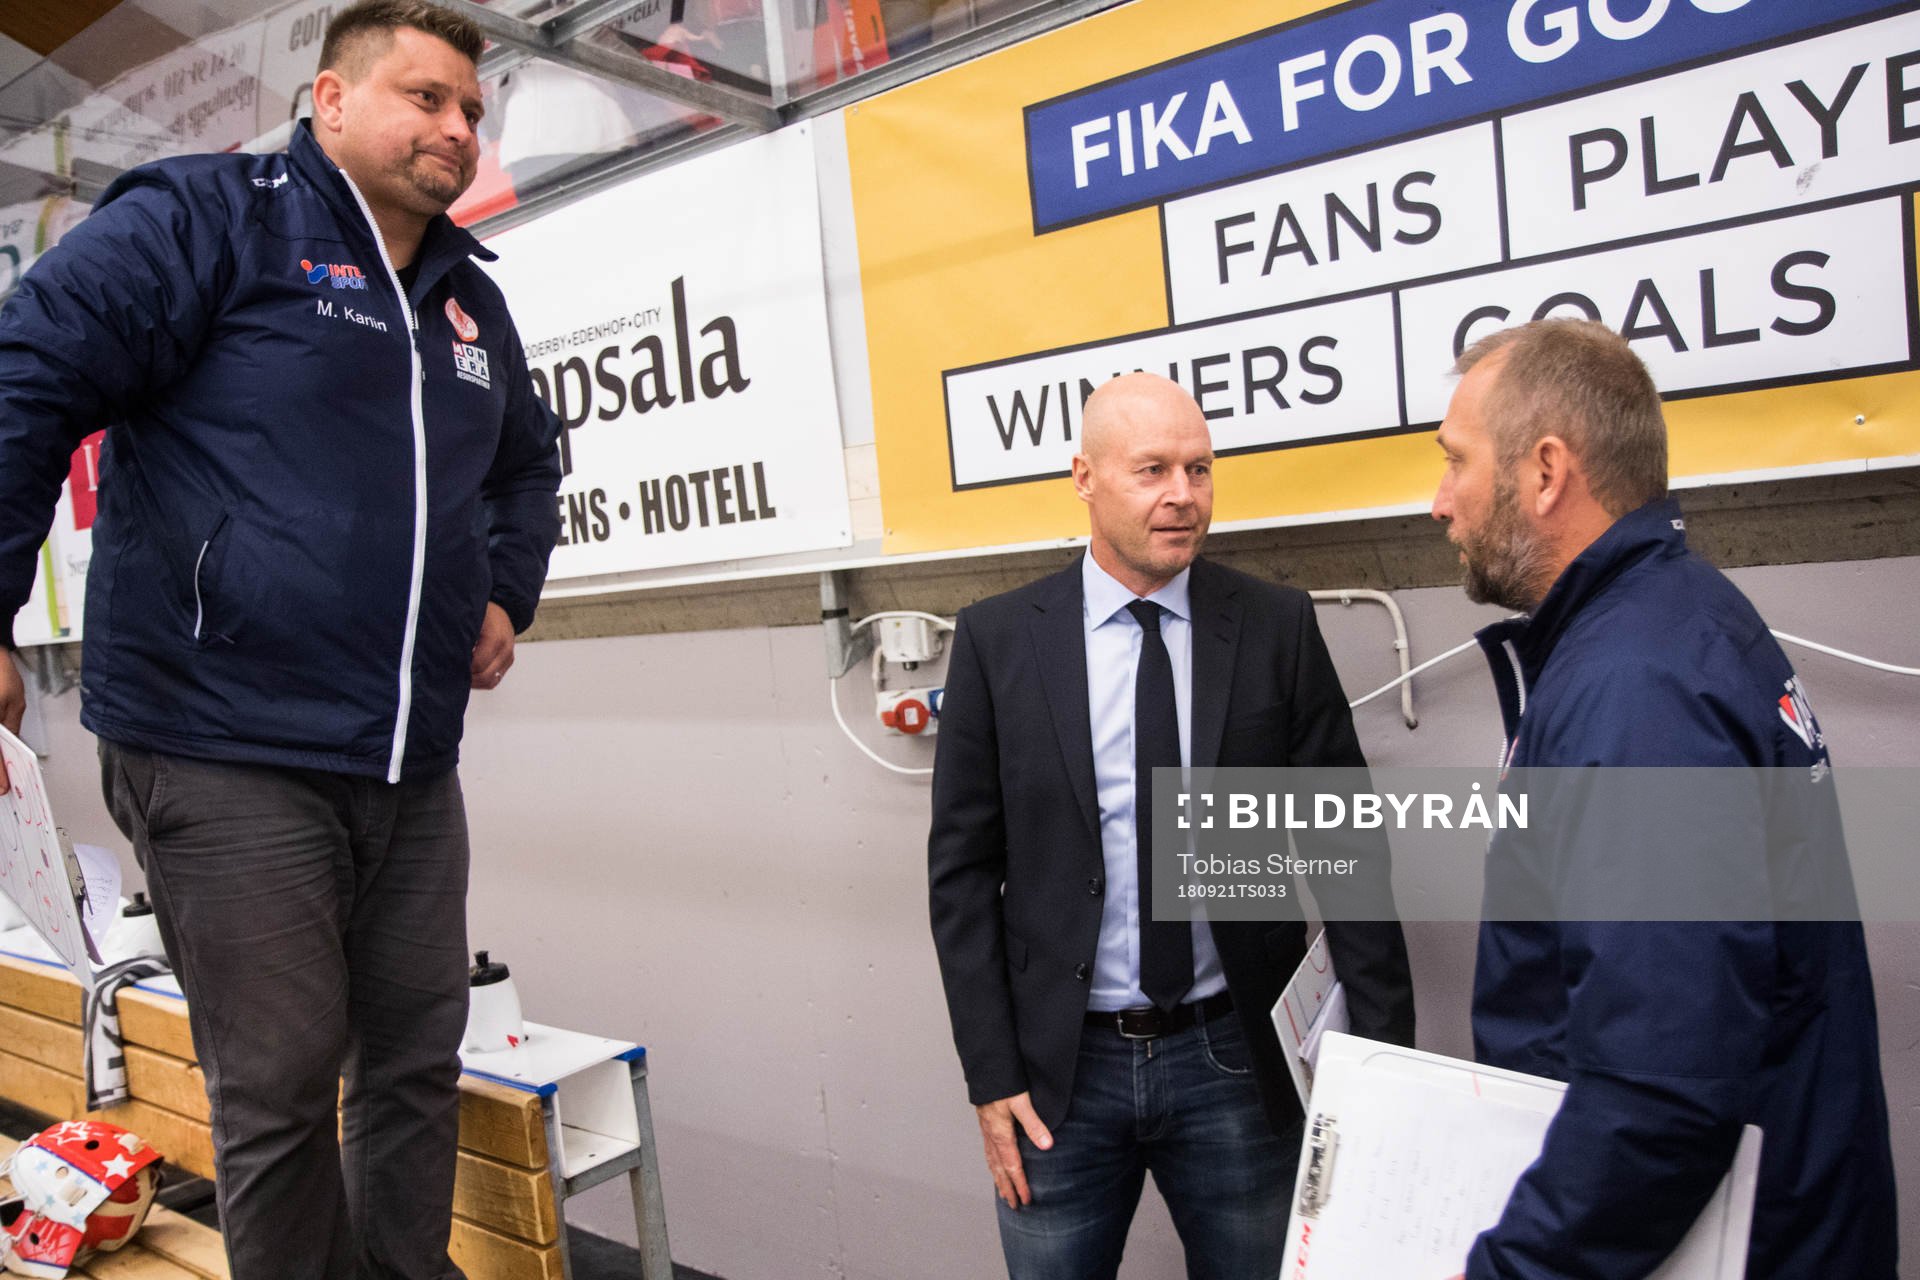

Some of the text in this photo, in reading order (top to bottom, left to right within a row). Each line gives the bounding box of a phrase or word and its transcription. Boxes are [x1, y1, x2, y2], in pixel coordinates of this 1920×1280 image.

[1071, 80, 1253, 190] FIKA
[1278, 11, 1473, 132] FOR
[1213, 170, 1442, 285] FANS
[316, 299, 338, 319] M.
[633, 306, 662, 328] CITY
[986, 334, 1344, 451] WIERS
[639, 461, 777, 535] HOTELL
